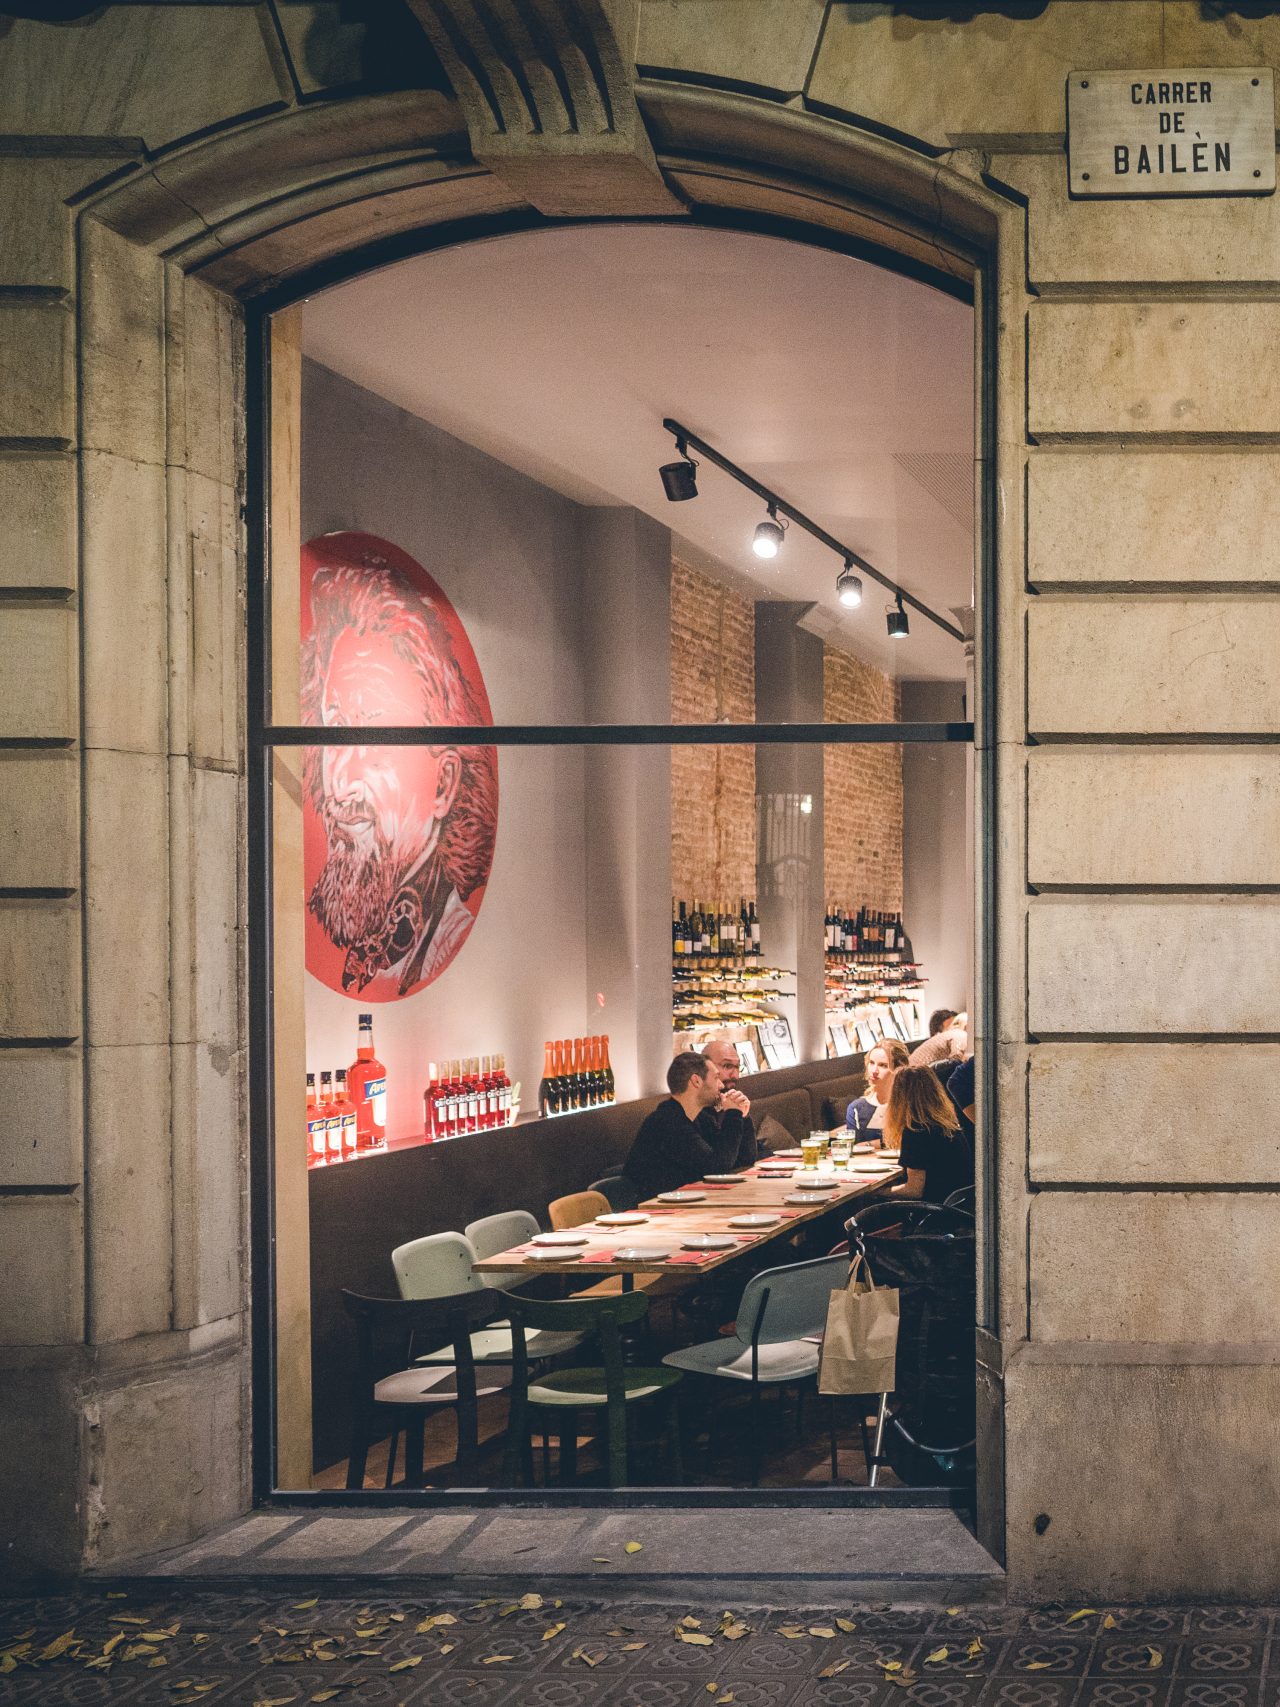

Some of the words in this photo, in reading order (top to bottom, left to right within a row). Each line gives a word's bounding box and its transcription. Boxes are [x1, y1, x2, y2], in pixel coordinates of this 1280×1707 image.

[1131, 82, 1212, 104] CARRER
[1159, 112, 1185, 134] DE
[1114, 131, 1231, 174] BAILÈN
